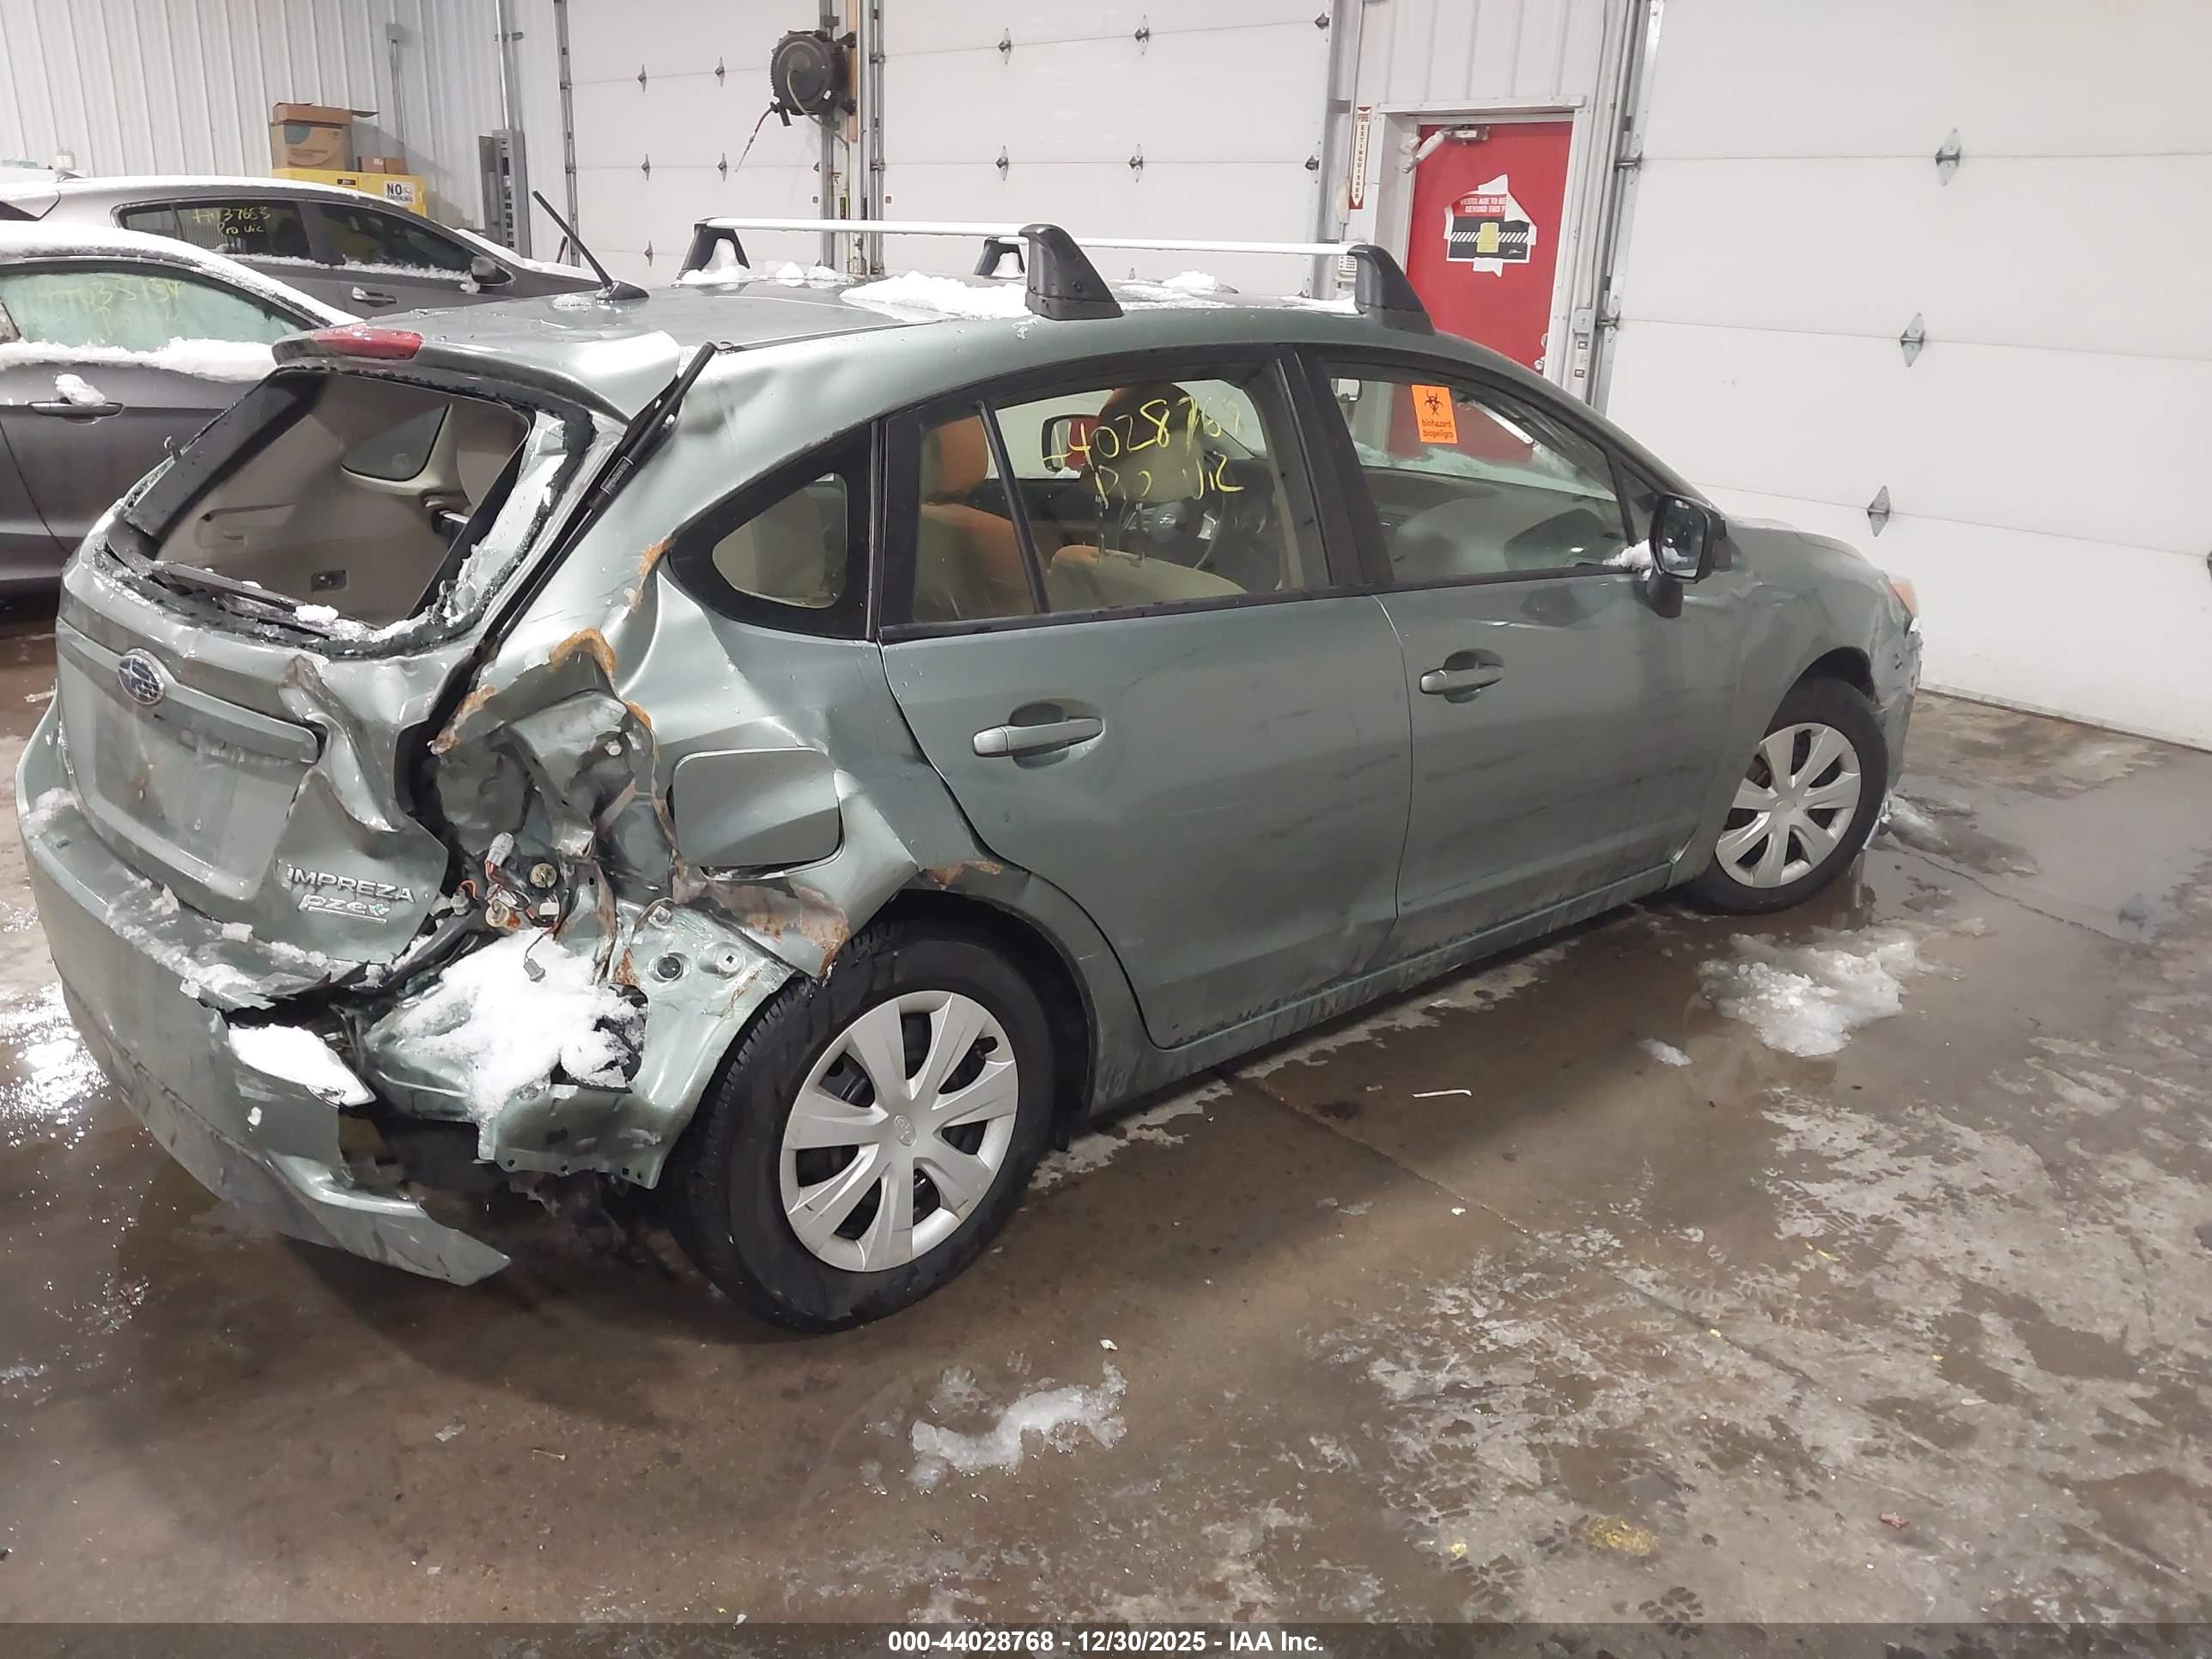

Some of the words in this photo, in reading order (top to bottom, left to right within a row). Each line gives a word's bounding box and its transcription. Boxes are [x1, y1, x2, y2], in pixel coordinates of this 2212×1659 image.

[386, 183, 402, 195] NO
[1422, 419, 1451, 428] biohazard
[1423, 429, 1454, 439] biopeligro
[287, 866, 416, 902] IMPREZA
